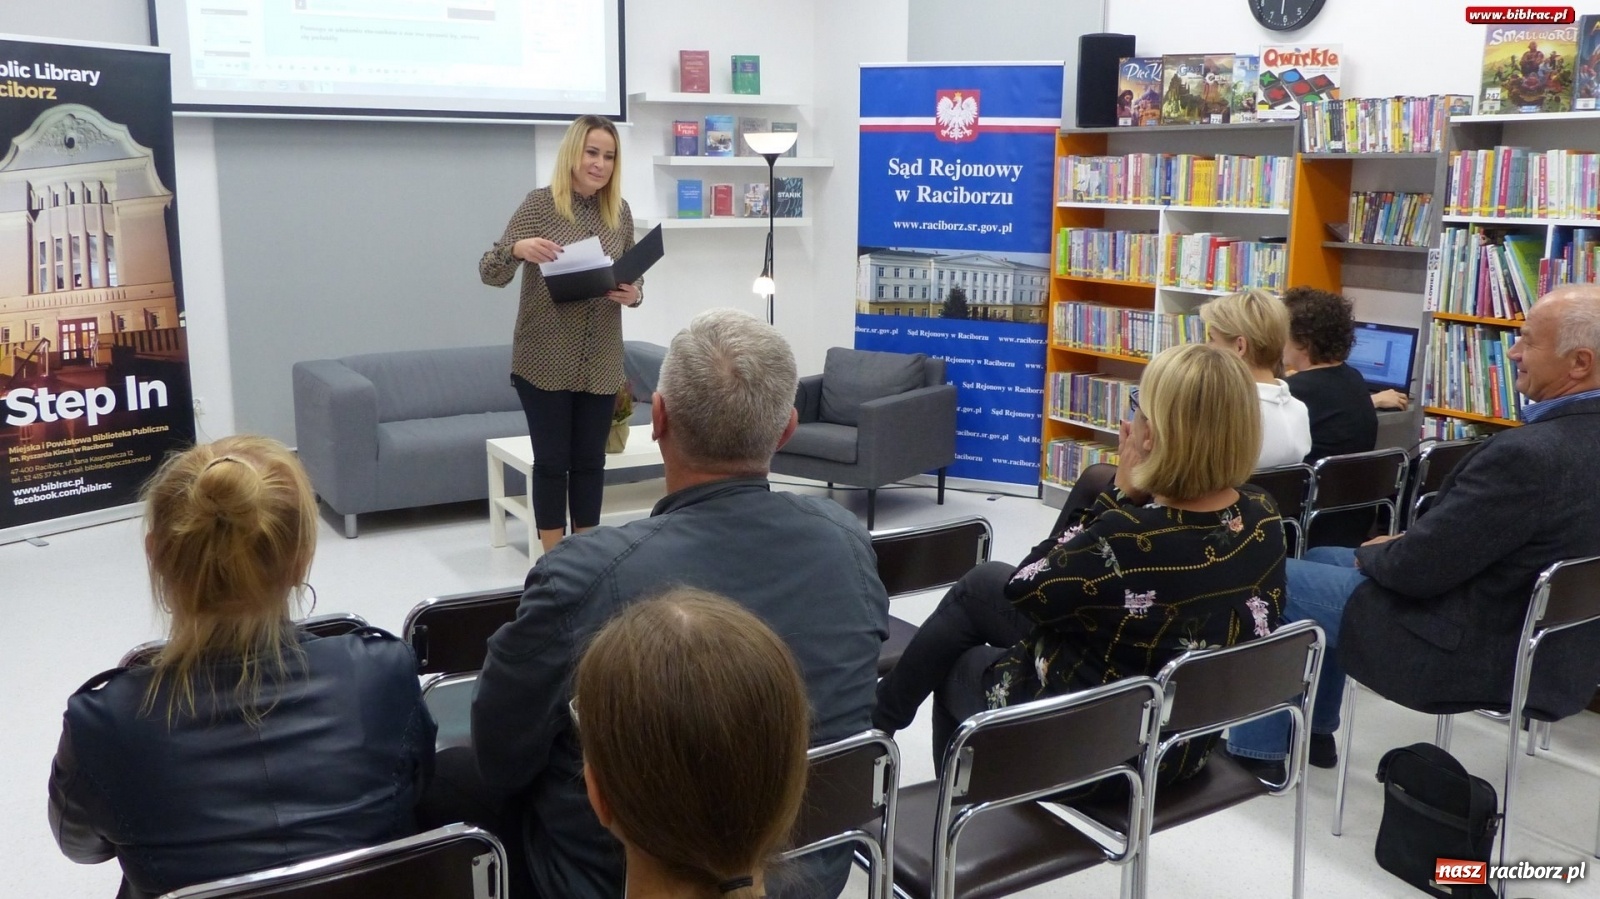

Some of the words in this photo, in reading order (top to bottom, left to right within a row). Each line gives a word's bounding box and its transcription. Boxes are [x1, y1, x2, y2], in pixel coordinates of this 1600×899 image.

[1264, 48, 1339, 67] Qwirkle
[34, 62, 100, 86] Library
[888, 157, 923, 179] Sąd
[929, 158, 1023, 182] Rejonowy
[895, 190, 910, 202] w
[916, 185, 1013, 205] Raciborzu
[894, 220, 1012, 235] www.raciborz.sr.gov.pl
[920, 330, 949, 339] Rejonowy
[958, 332, 989, 340] Raciborzu
[945, 356, 975, 365] Rejonowy
[984, 358, 1015, 367] Raciborzu
[976, 383, 1005, 392] Rejonowy
[6, 386, 116, 426] Step
[125, 375, 168, 411] In
[1005, 409, 1035, 419] Rejonowy
[9, 444, 40, 454] Miejska
[46, 437, 91, 448] Powiatowa
[93, 430, 131, 441] Biblioteka
[132, 425, 169, 435] Publiczna
[21, 451, 52, 461] Ryszarda
[82, 442, 113, 451] Raciborzu
[12, 477, 84, 496] www.biblrac.pl
[14, 483, 112, 506] facebook.com/biblrac
